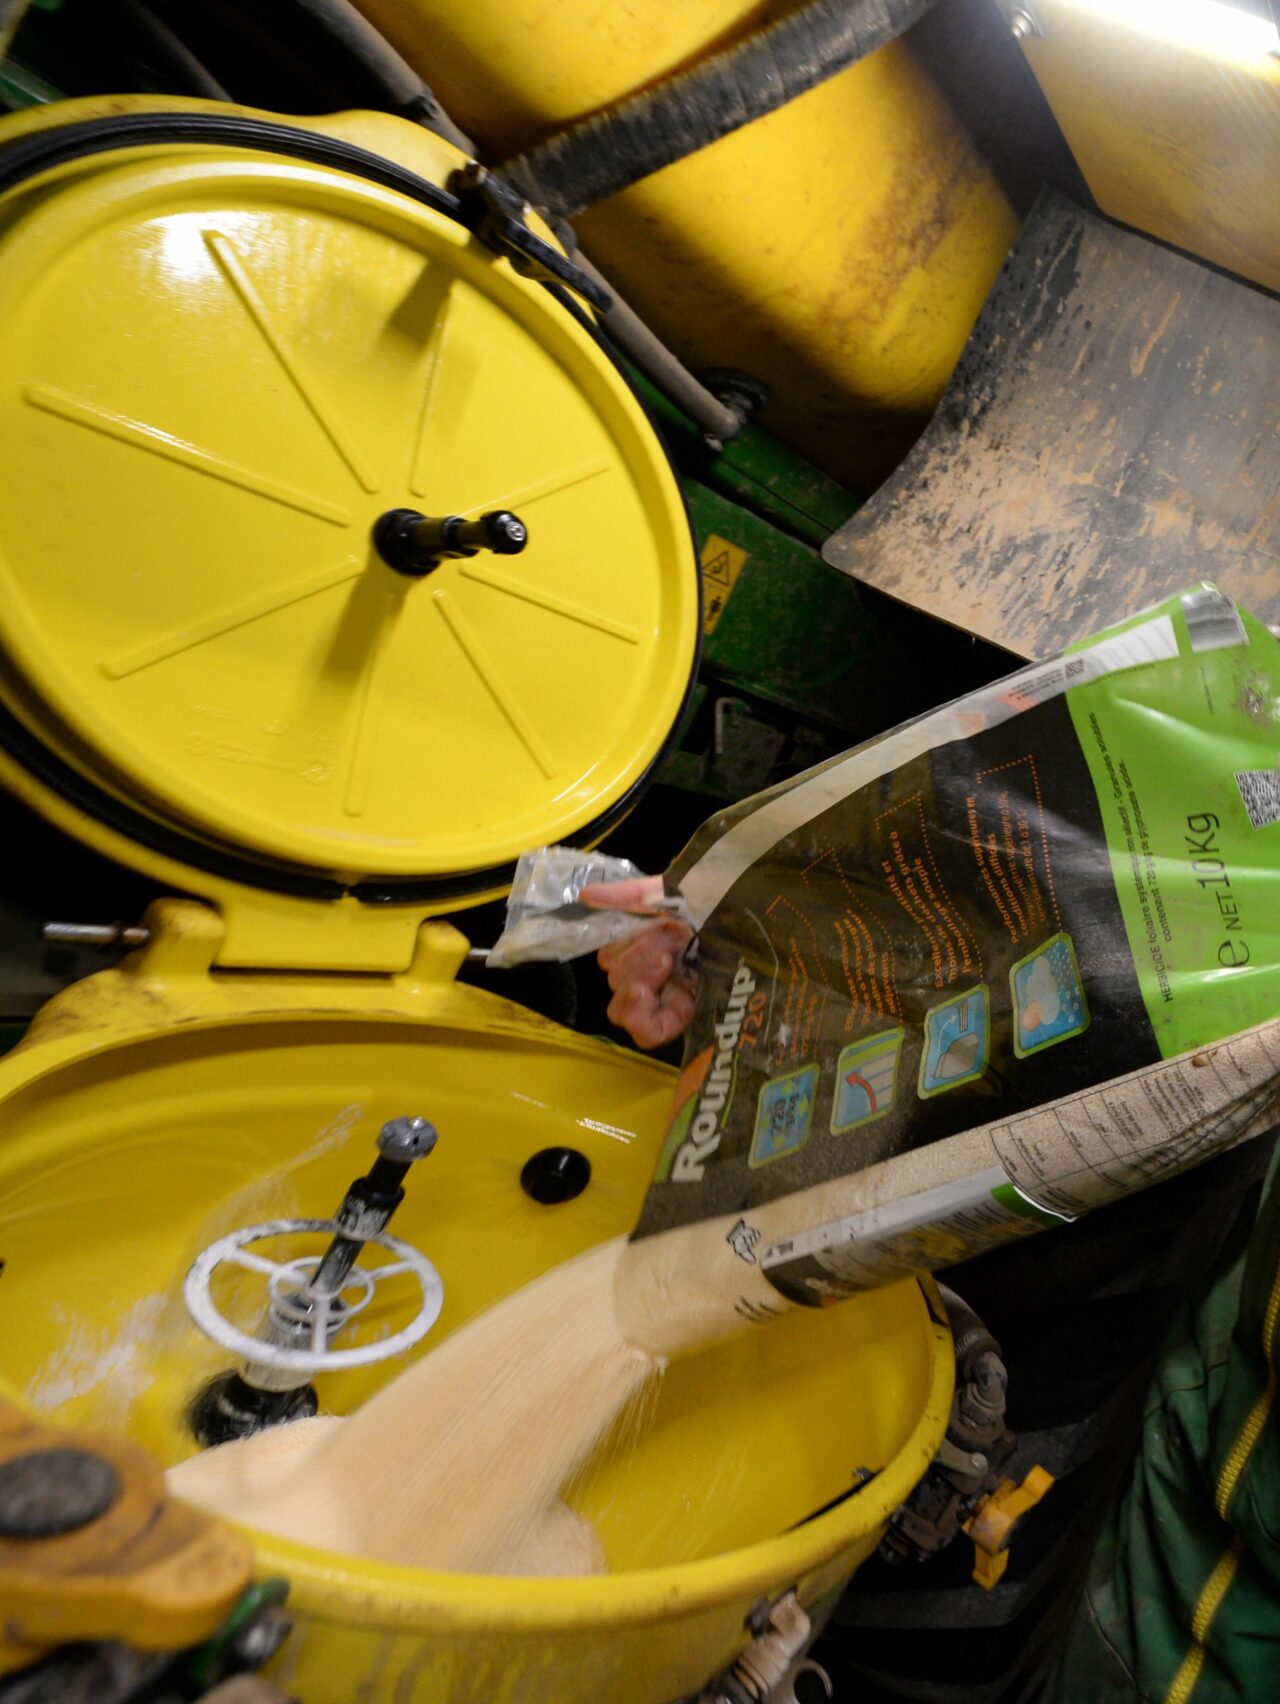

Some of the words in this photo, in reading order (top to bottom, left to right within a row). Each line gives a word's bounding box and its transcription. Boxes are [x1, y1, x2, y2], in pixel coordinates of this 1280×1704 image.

[965, 796, 975, 809] en
[887, 830, 898, 841] à
[891, 841, 912, 876] grâce
[880, 859, 893, 874] et
[910, 857, 936, 900] souple
[885, 874, 925, 924] praticité
[903, 877, 936, 924] déchets
[979, 867, 1020, 944] Performances
[997, 877, 1029, 936] conditions
[1150, 888, 1173, 943] contenant
[1215, 891, 1243, 931] NET
[932, 900, 972, 974] l'emballage
[933, 924, 948, 941] de
[1141, 906, 1158, 944] foliaire
[921, 925, 944, 988] Excellente
[944, 941, 957, 980] moins
[1149, 945, 1174, 1002] HERBICIDE
[880, 952, 896, 1014] adjuvants
[738, 991, 768, 1051] 720
[671, 964, 757, 1182] Roundup
